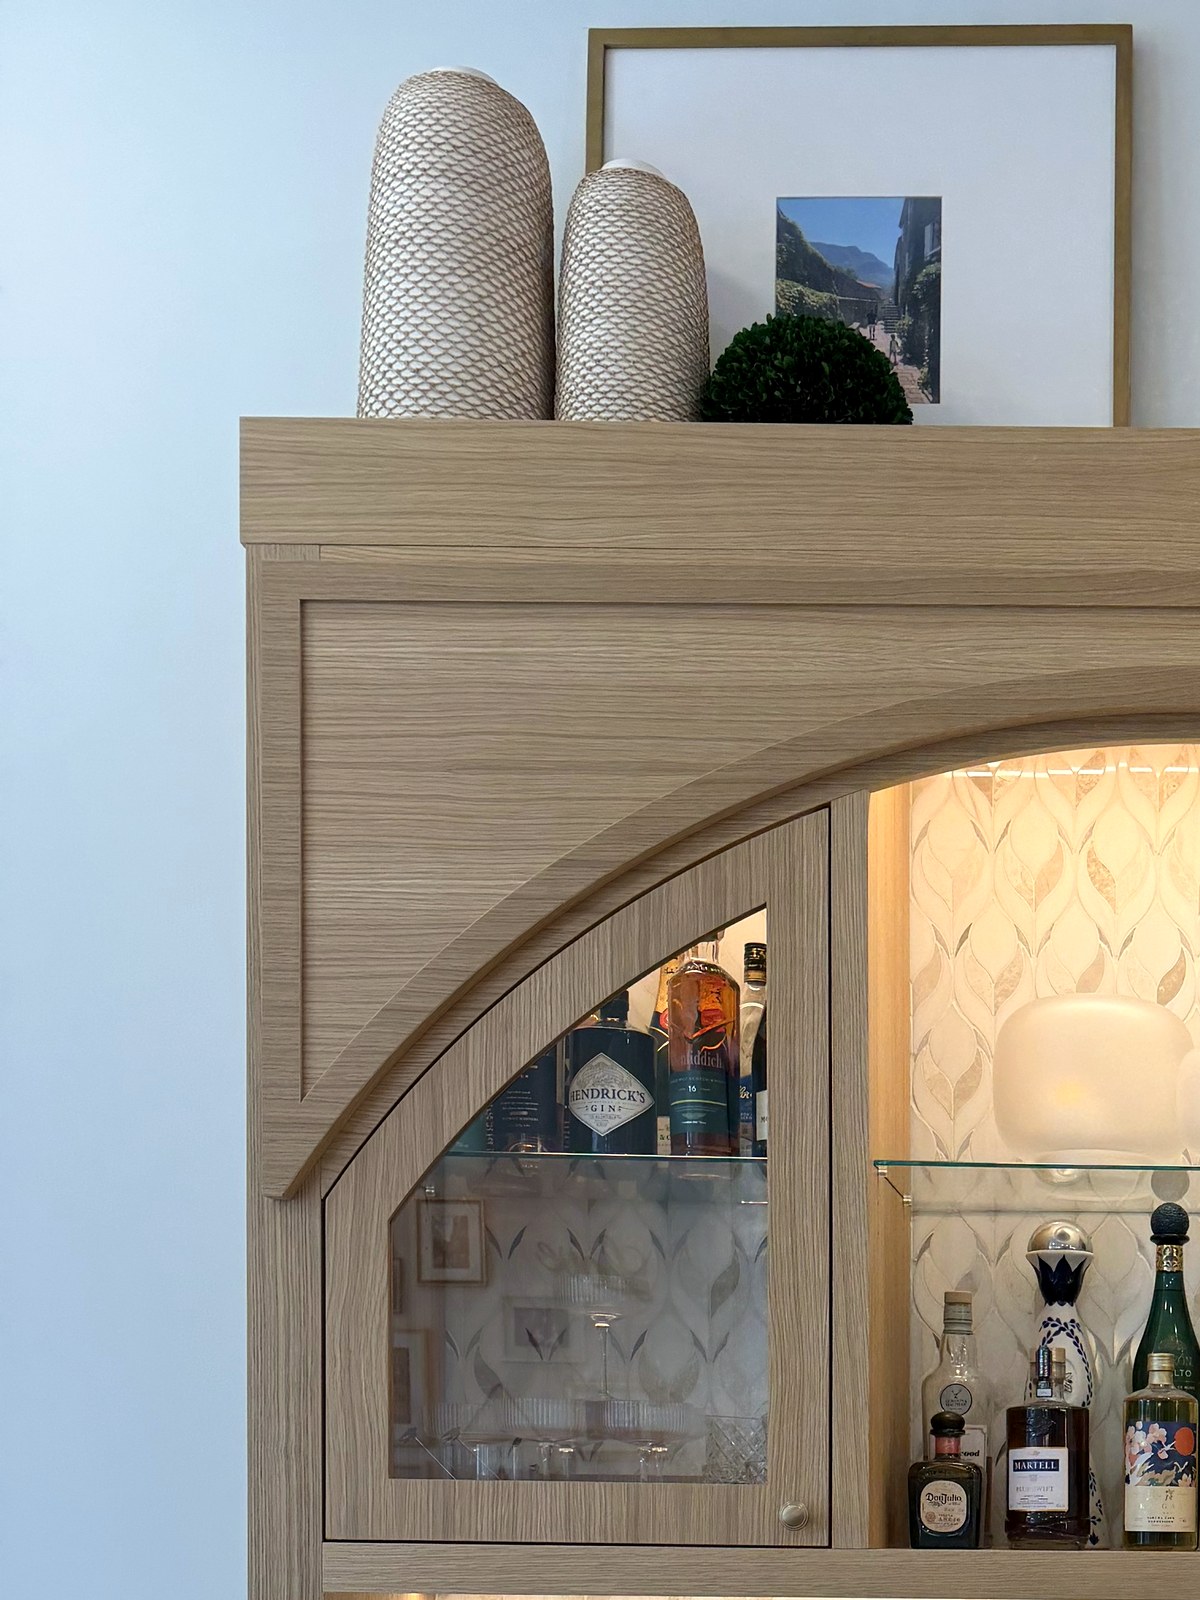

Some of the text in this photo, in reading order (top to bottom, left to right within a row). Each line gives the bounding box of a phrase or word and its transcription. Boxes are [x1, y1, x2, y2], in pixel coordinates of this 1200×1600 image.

[680, 1051, 722, 1068] nfiddich
[688, 1085, 697, 1093] 16
[569, 1088, 646, 1104] HENDRICK'S
[590, 1104, 617, 1113] GIN
[1174, 1369, 1193, 1378] LTO
[1014, 1461, 1058, 1470] MARTELL
[925, 1492, 962, 1505] Don Julio
